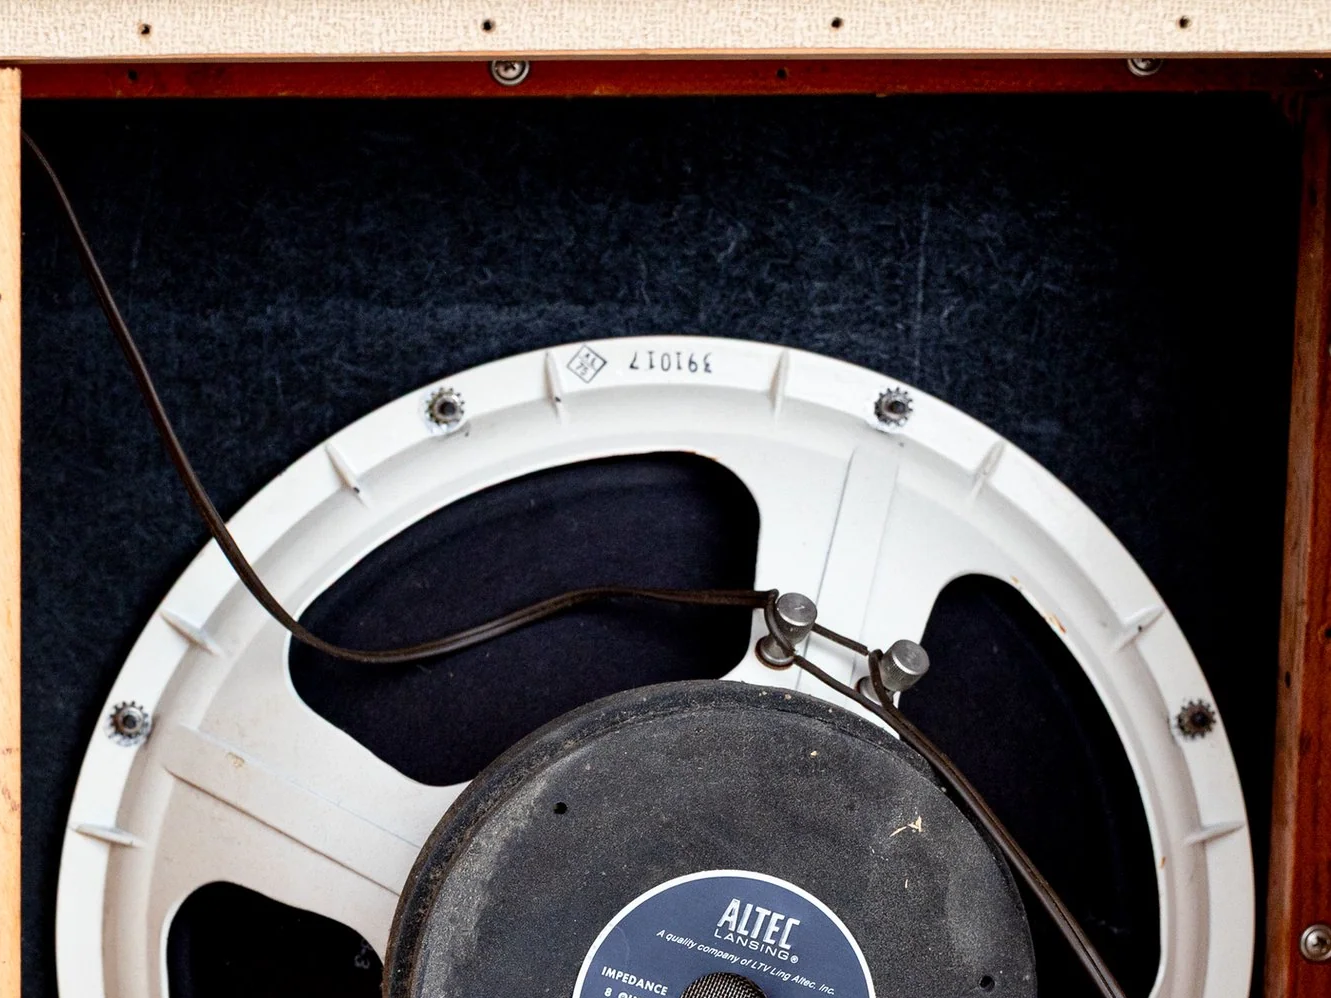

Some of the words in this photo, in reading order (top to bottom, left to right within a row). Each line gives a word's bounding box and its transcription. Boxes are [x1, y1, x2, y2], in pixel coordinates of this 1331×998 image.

[629, 350, 713, 373] 391017
[717, 898, 800, 949] ALTEC
[656, 929, 665, 937] A
[665, 933, 696, 950] quality
[697, 943, 740, 964] company
[740, 957, 751, 966] of
[751, 961, 770, 974] LTV
[769, 967, 791, 981] Ling
[819, 984, 835, 996] Inc.
[601, 966, 668, 996] IMPEDANCE
[604, 987, 611, 997] 8
